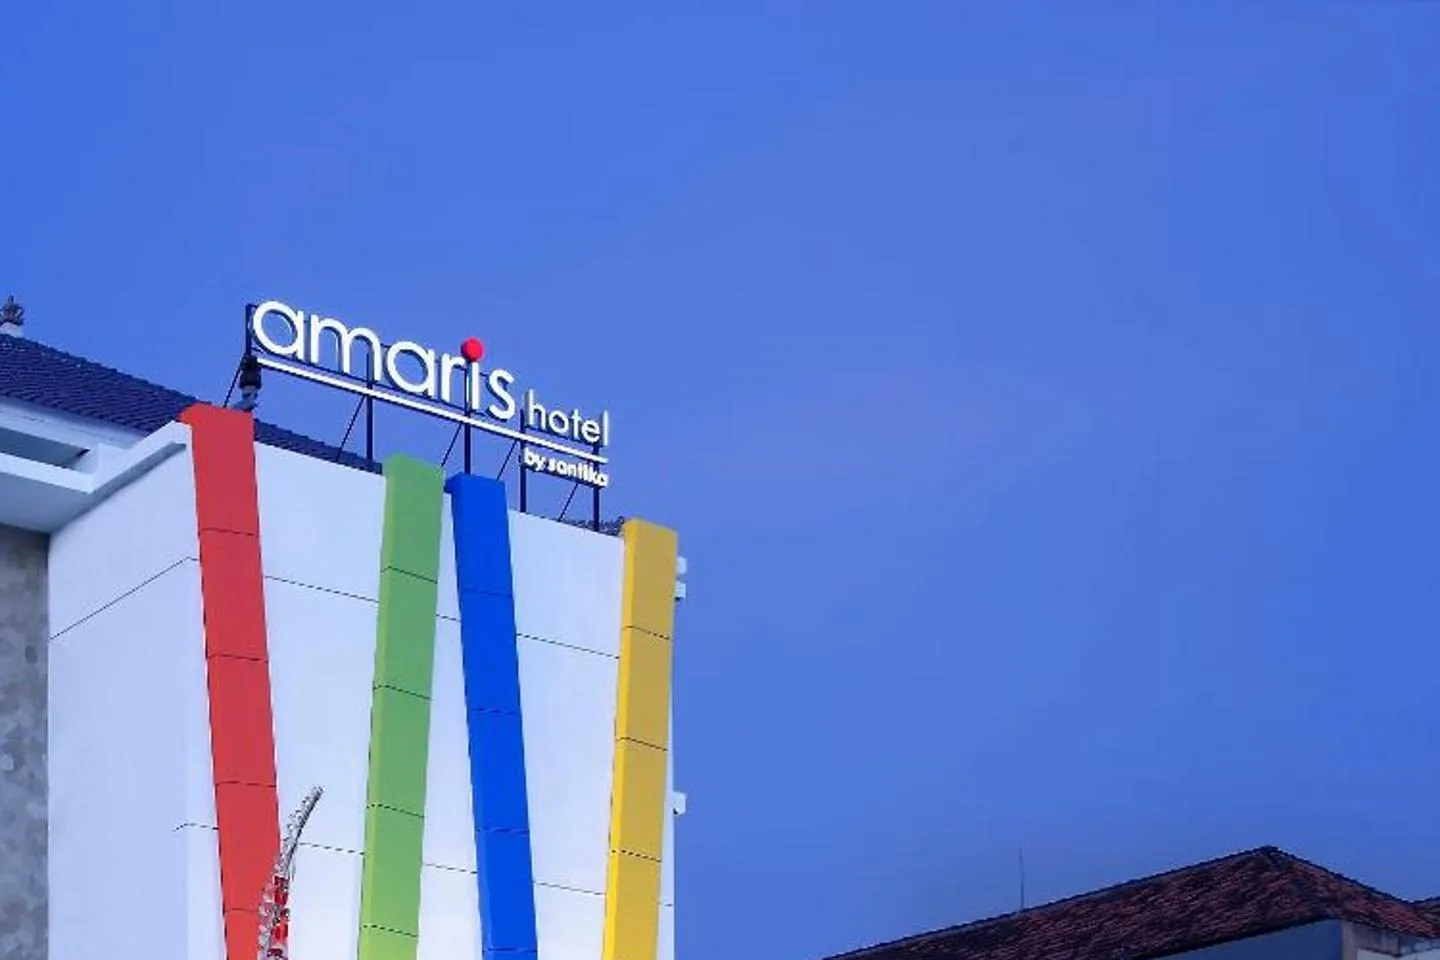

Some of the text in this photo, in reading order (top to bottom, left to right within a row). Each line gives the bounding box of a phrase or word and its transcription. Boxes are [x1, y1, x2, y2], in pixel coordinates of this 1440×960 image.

[252, 300, 608, 447] amaris hotel
[524, 447, 609, 487] by santika
